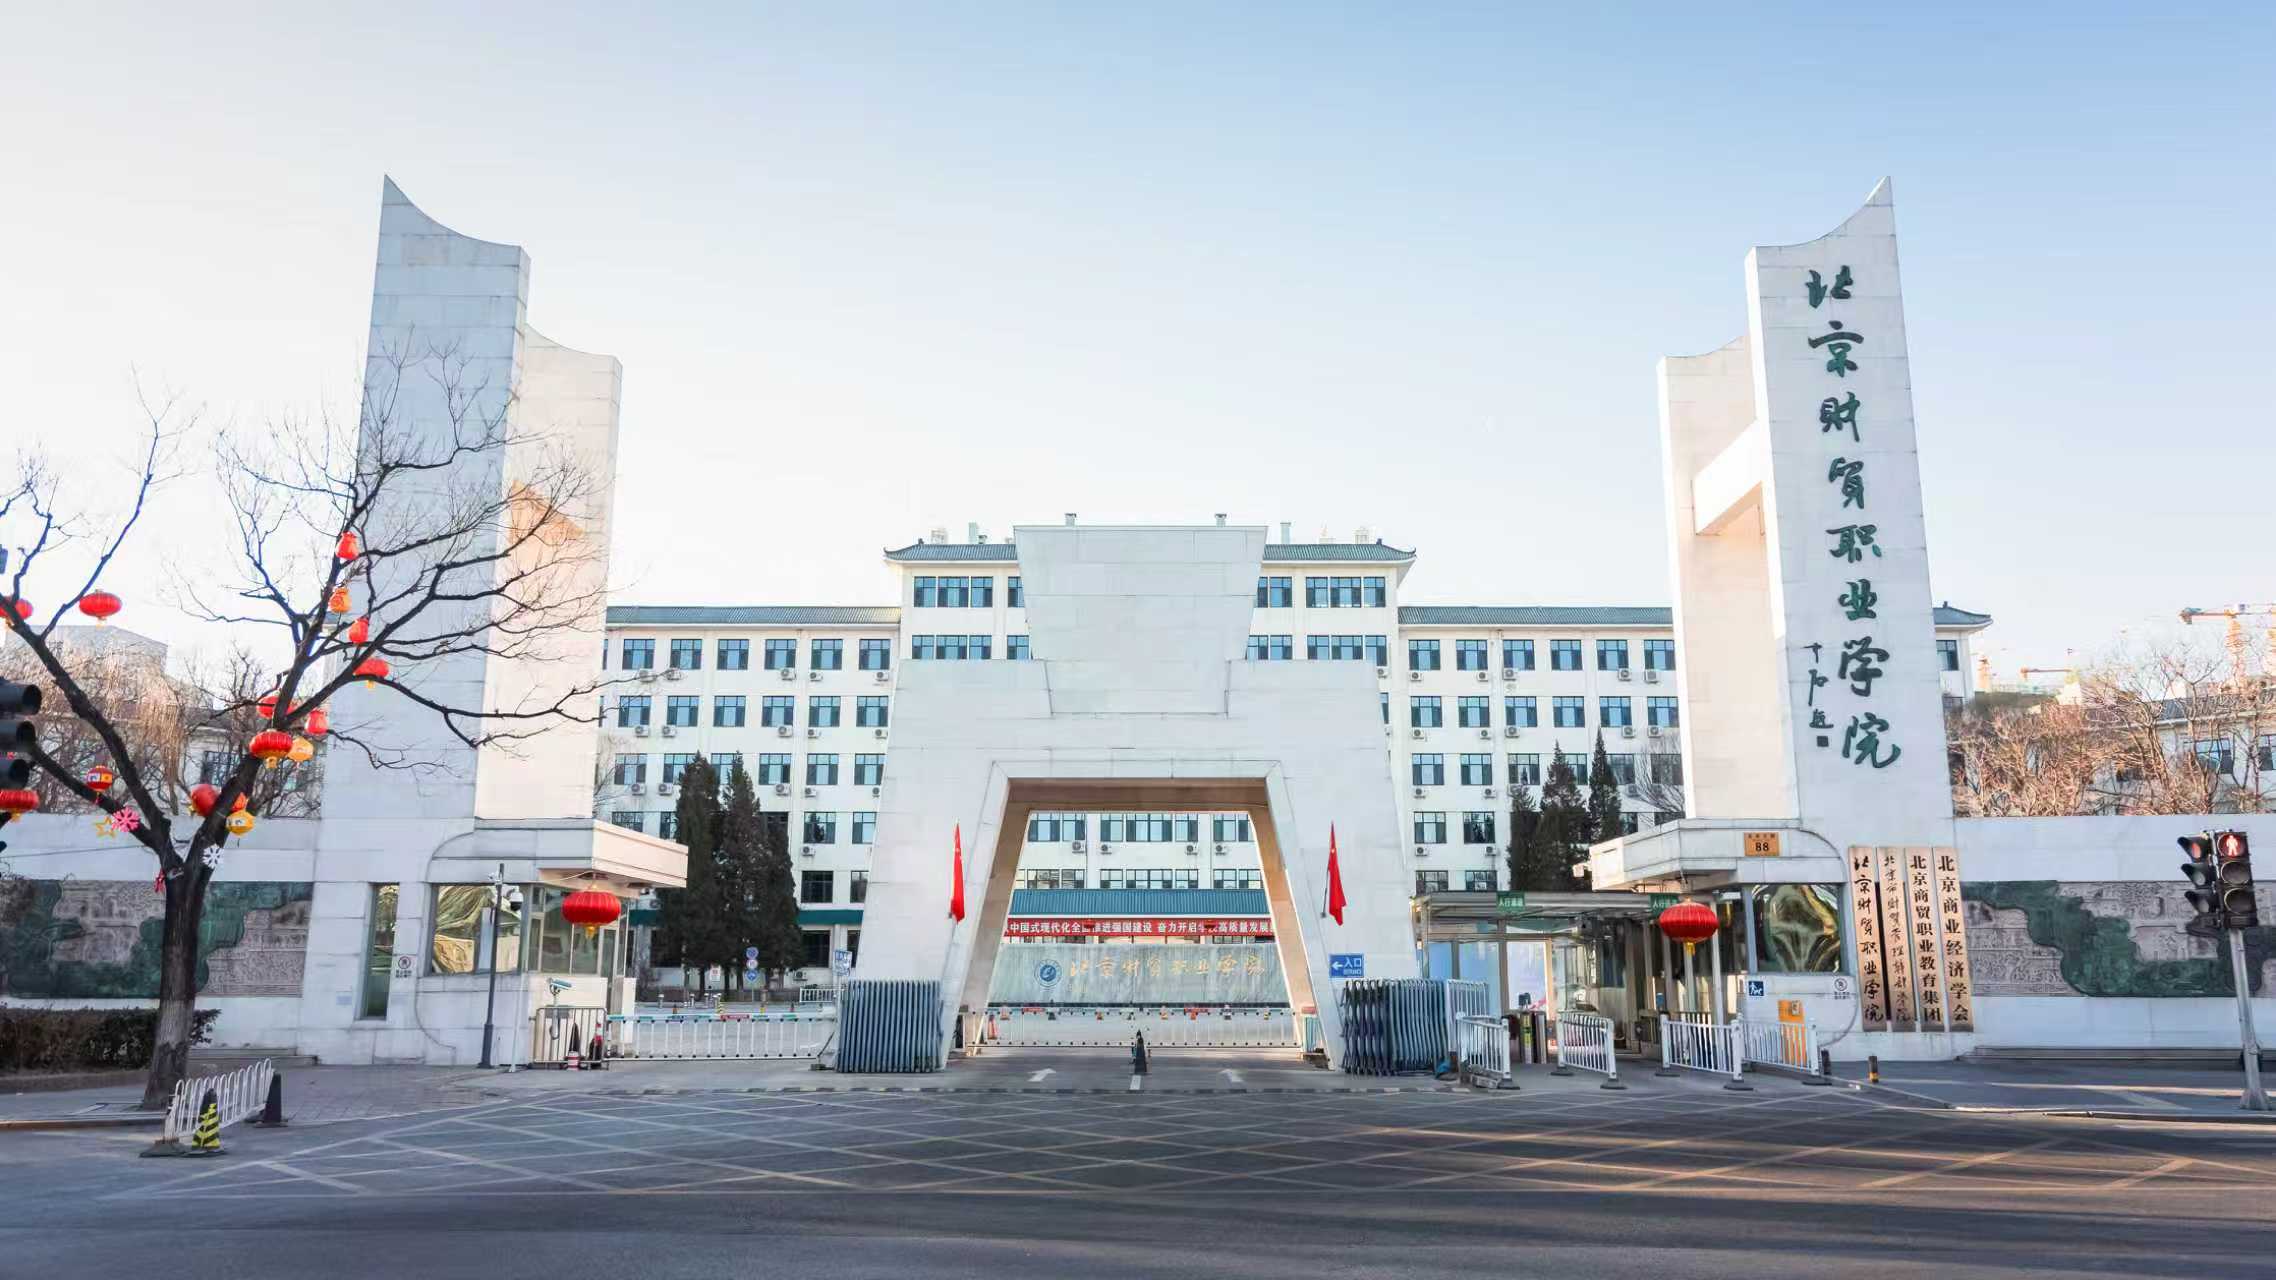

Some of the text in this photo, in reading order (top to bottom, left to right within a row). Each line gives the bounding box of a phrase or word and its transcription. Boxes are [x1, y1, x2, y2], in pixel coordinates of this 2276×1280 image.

[1755, 841, 1769, 851] 88
[1344, 956, 1362, 968] 入口
[1910, 855, 1941, 1022] 北京商贸职业教育集团
[1938, 855, 1968, 1021] 北京商业经济学会
